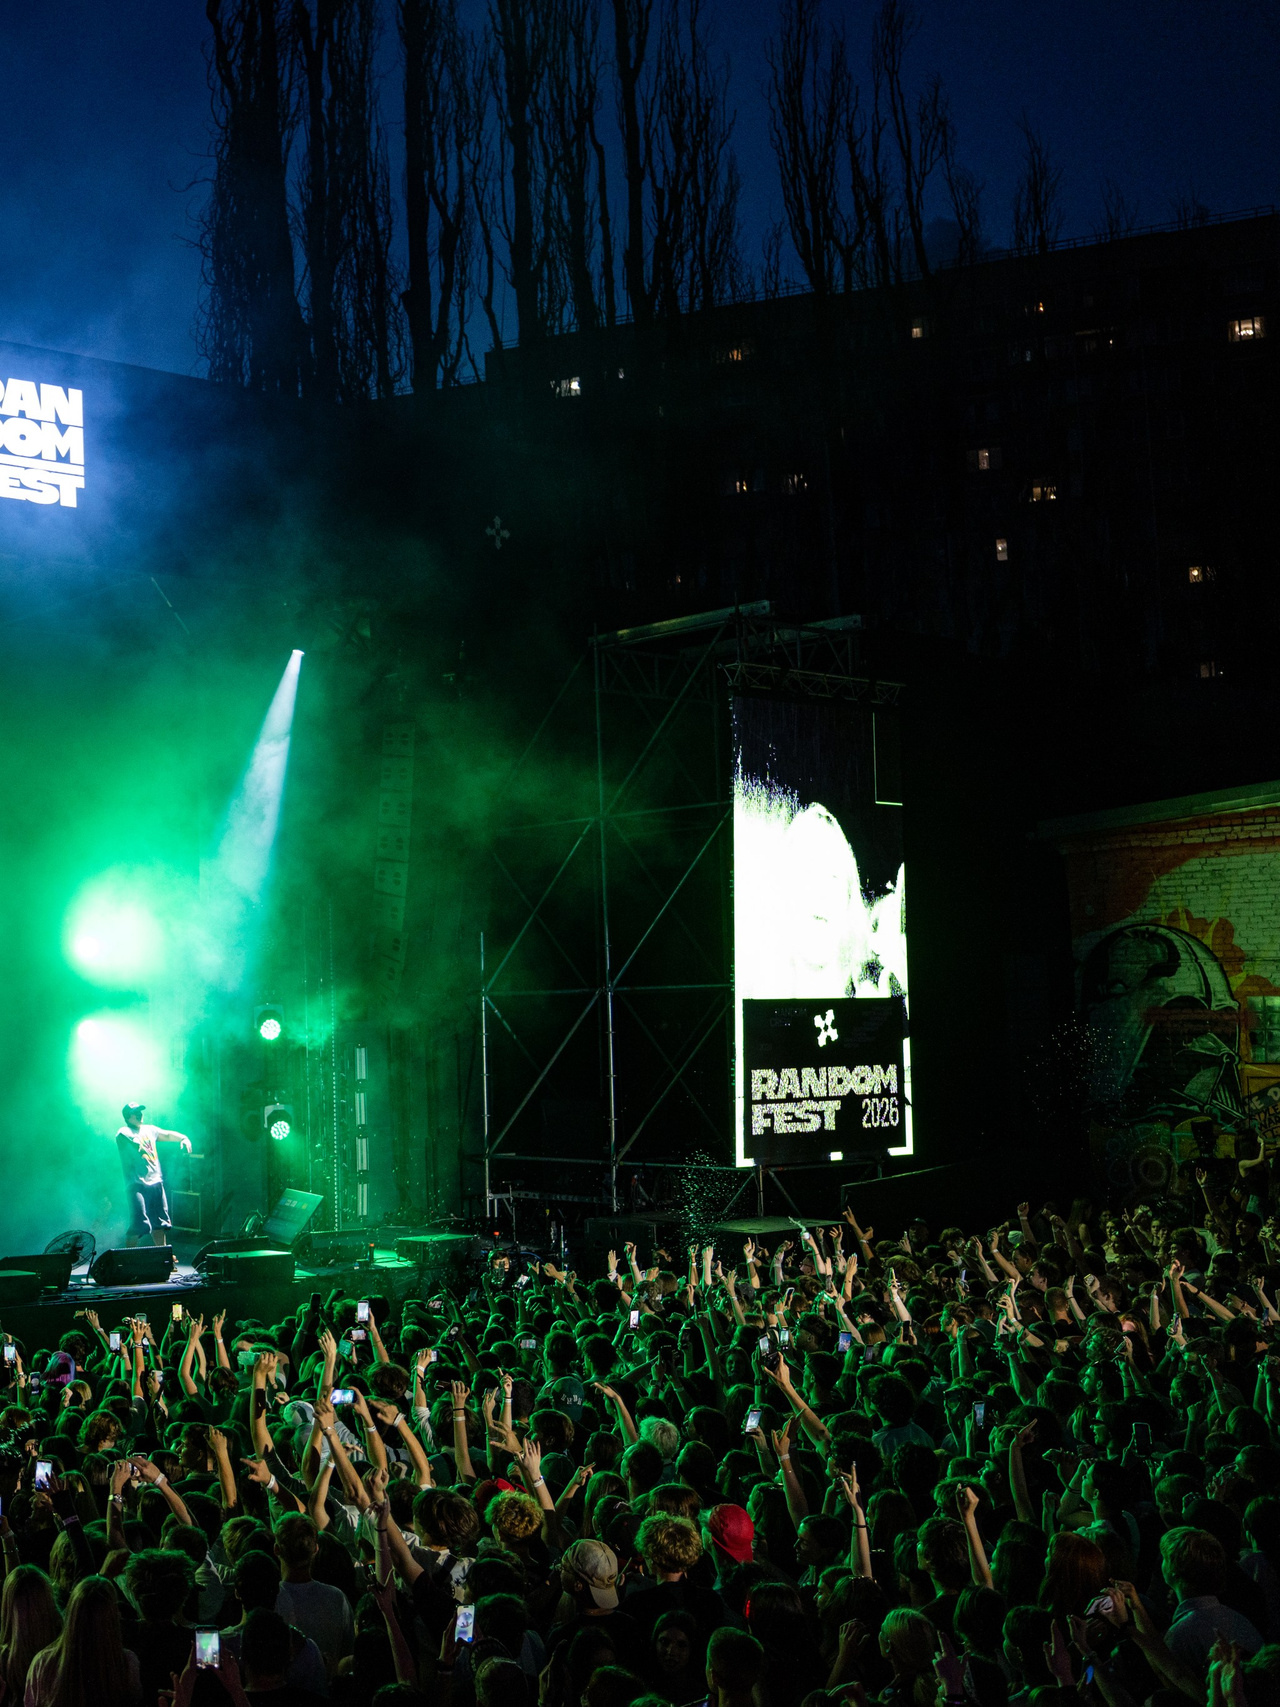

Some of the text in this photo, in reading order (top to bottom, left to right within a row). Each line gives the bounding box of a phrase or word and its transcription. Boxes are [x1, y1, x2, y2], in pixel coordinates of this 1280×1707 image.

[751, 1064, 898, 1100] RANDOM
[751, 1097, 900, 1136] FEST 2026
